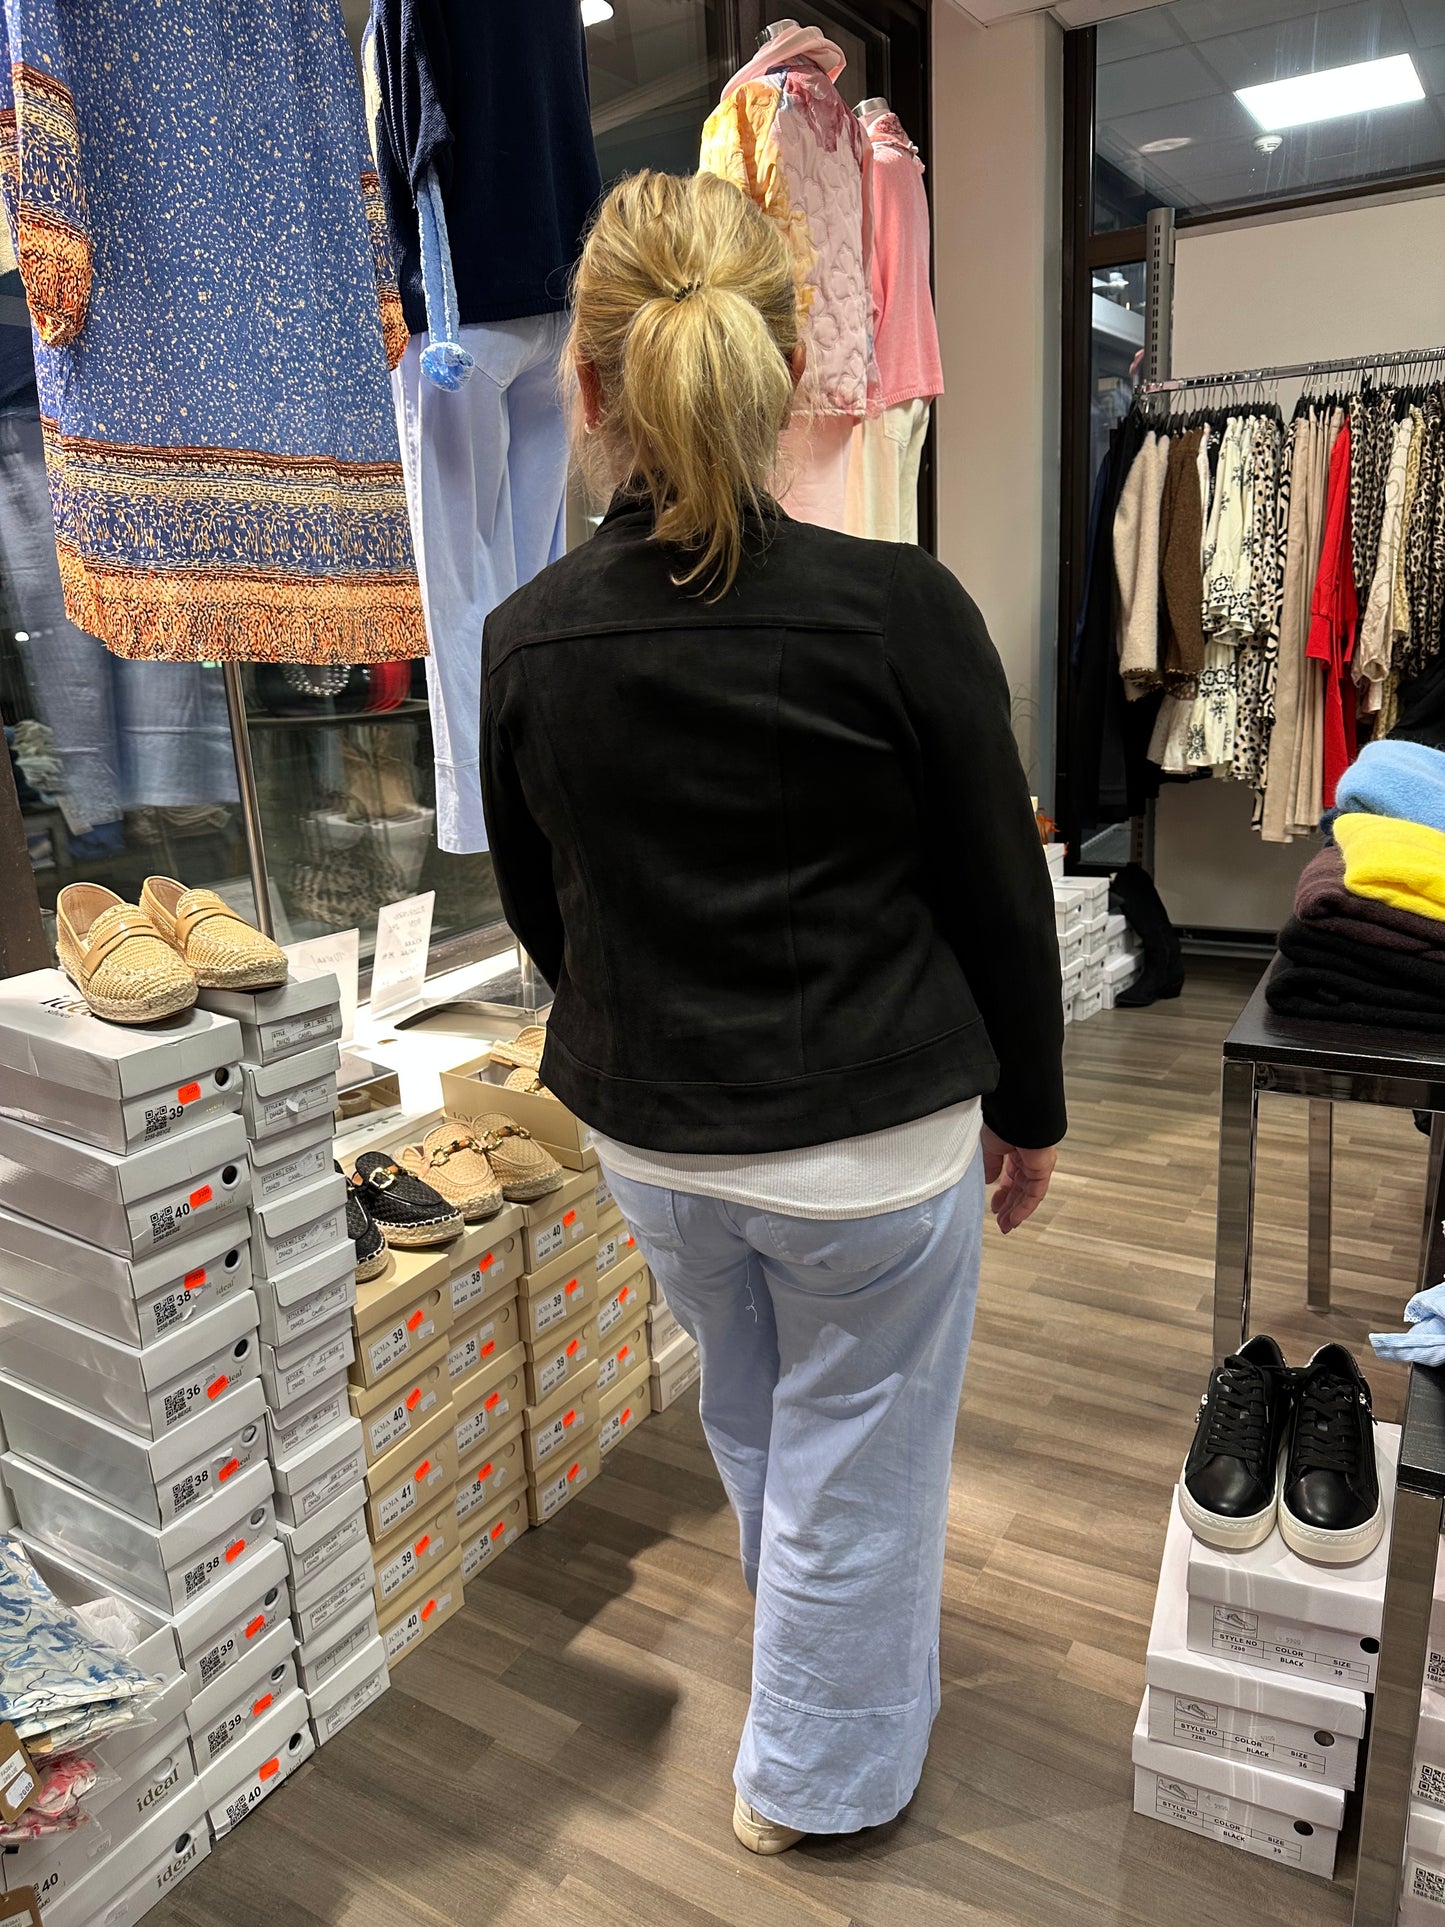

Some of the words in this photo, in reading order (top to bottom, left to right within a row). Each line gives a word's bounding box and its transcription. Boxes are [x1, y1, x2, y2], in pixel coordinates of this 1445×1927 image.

[169, 1105, 184, 1121] 39
[175, 1202, 190, 1219] 40
[552, 1224, 561, 1237] 40
[606, 1242, 615, 1254] 38
[471, 1271, 481, 1285] 38
[215, 1279, 235, 1296] ideal
[176, 1290, 191, 1307] 38
[553, 1294, 562, 1307] 39
[612, 1298, 619, 1312] 37
[373, 1341, 391, 1359] JOIA
[392, 1328, 404, 1344] 39
[393, 1343, 408, 1358] BLACK
[465, 1340, 475, 1355] 38
[464, 1355, 477, 1368] BLACK
[556, 1356, 565, 1370] 39
[607, 1359, 614, 1371] 37
[227, 1368, 243, 1384] deal
[186, 1384, 201, 1400] 36
[373, 1420, 391, 1437] JOIA
[393, 1406, 404, 1422] 40
[474, 1412, 484, 1427] 37
[554, 1420, 562, 1434] 40
[393, 1421, 407, 1436] BLACK
[473, 1426, 486, 1440] BLACK
[194, 1470, 209, 1487] 38
[558, 1477, 566, 1490] 41
[472, 1480, 482, 1495] 38
[382, 1497, 399, 1514] JOIA
[401, 1484, 411, 1499] 41
[400, 1499, 414, 1513] BLACK
[470, 1495, 483, 1508] BLACK
[479, 1535, 489, 1550] 38
[206, 1556, 220, 1573] 38
[383, 1564, 400, 1582] JOIA
[401, 1551, 412, 1567] 39
[401, 1564, 415, 1580] BLACK
[388, 1627, 405, 1644] JOIA
[407, 1614, 418, 1629] 40
[406, 1628, 420, 1643] BLACK
[220, 1639, 234, 1656] 39
[1219, 1633, 1245, 1645] STYLE
[1275, 1646, 1304, 1658] COLOR
[1333, 1659, 1352, 1669] SIZE
[1280, 1657, 1304, 1668] BLACK
[228, 1713, 242, 1731] 39
[1180, 1723, 1206, 1734] STYLE
[1206, 1729, 1218, 1737] NO
[1234, 1736, 1263, 1748] COLOR
[1290, 1750, 1309, 1760] SIZE
[1246, 1747, 1270, 1758] BLACK
[1298, 1761, 1308, 1769] 36
[136, 1766, 180, 1813] ideal
[248, 1785, 262, 1803] 40
[1162, 1801, 1186, 1813] STYLE
[1186, 1809, 1198, 1817] NO
[1214, 1818, 1241, 1831] COLOR
[1267, 1836, 1285, 1846] SIZE
[1223, 1830, 1245, 1842] BLACK
[1273, 1846, 1282, 1854] 39
[156, 1843, 198, 1889] ideal
[41, 1872, 59, 1892] 40
